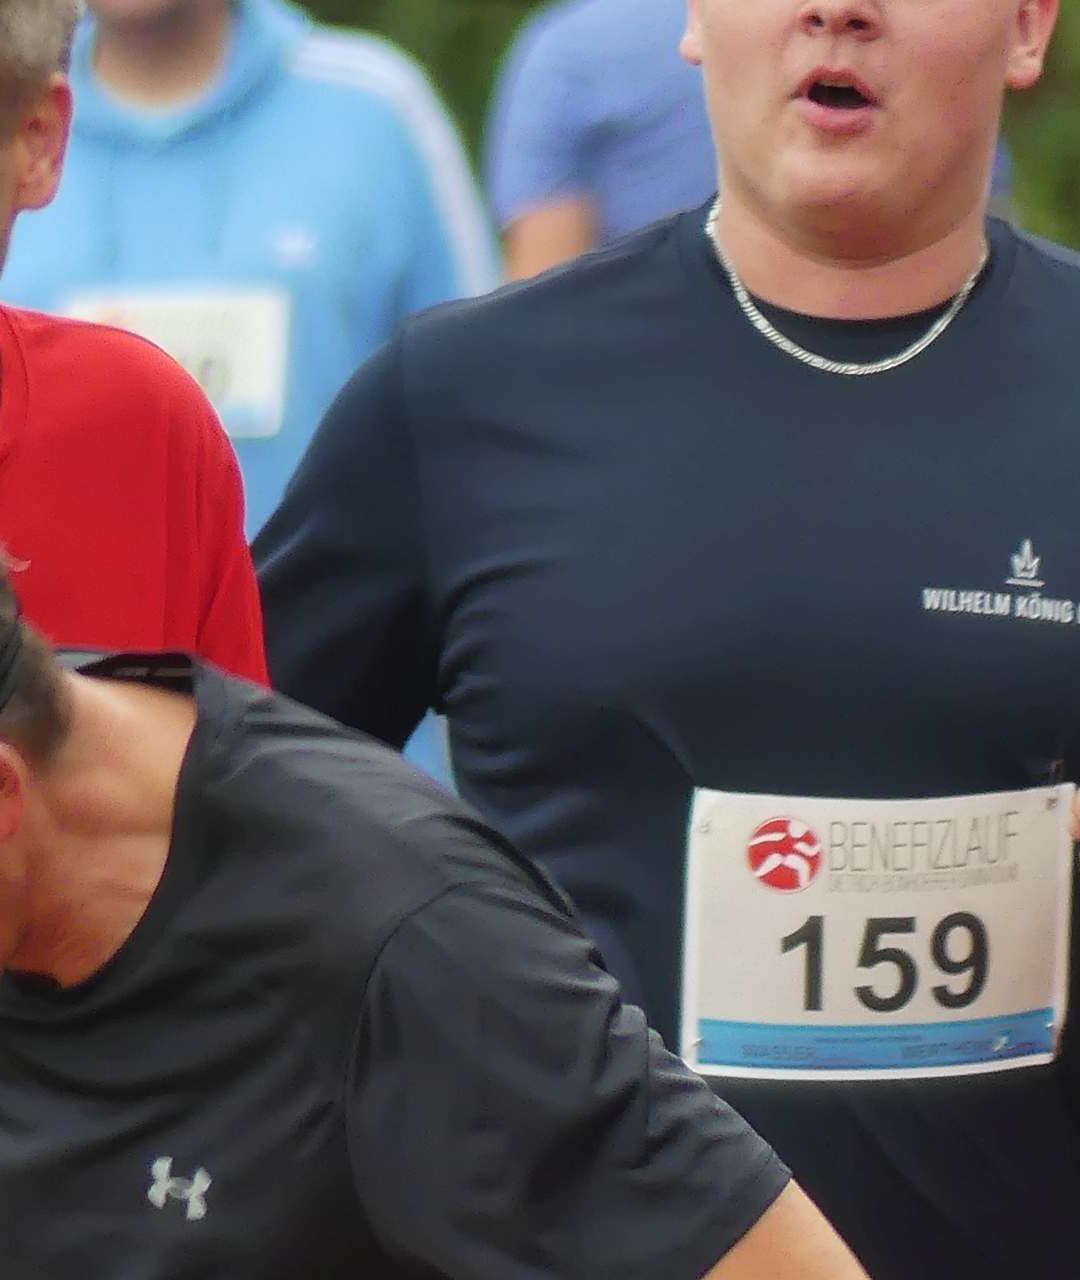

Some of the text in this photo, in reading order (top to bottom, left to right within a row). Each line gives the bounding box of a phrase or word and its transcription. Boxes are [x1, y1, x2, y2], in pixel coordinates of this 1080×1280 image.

[922, 588, 1011, 616] WILHELM
[1014, 592, 1074, 624] KÖNIG
[829, 811, 1020, 873] BENEFIZLAUF
[780, 911, 990, 1013] 159
